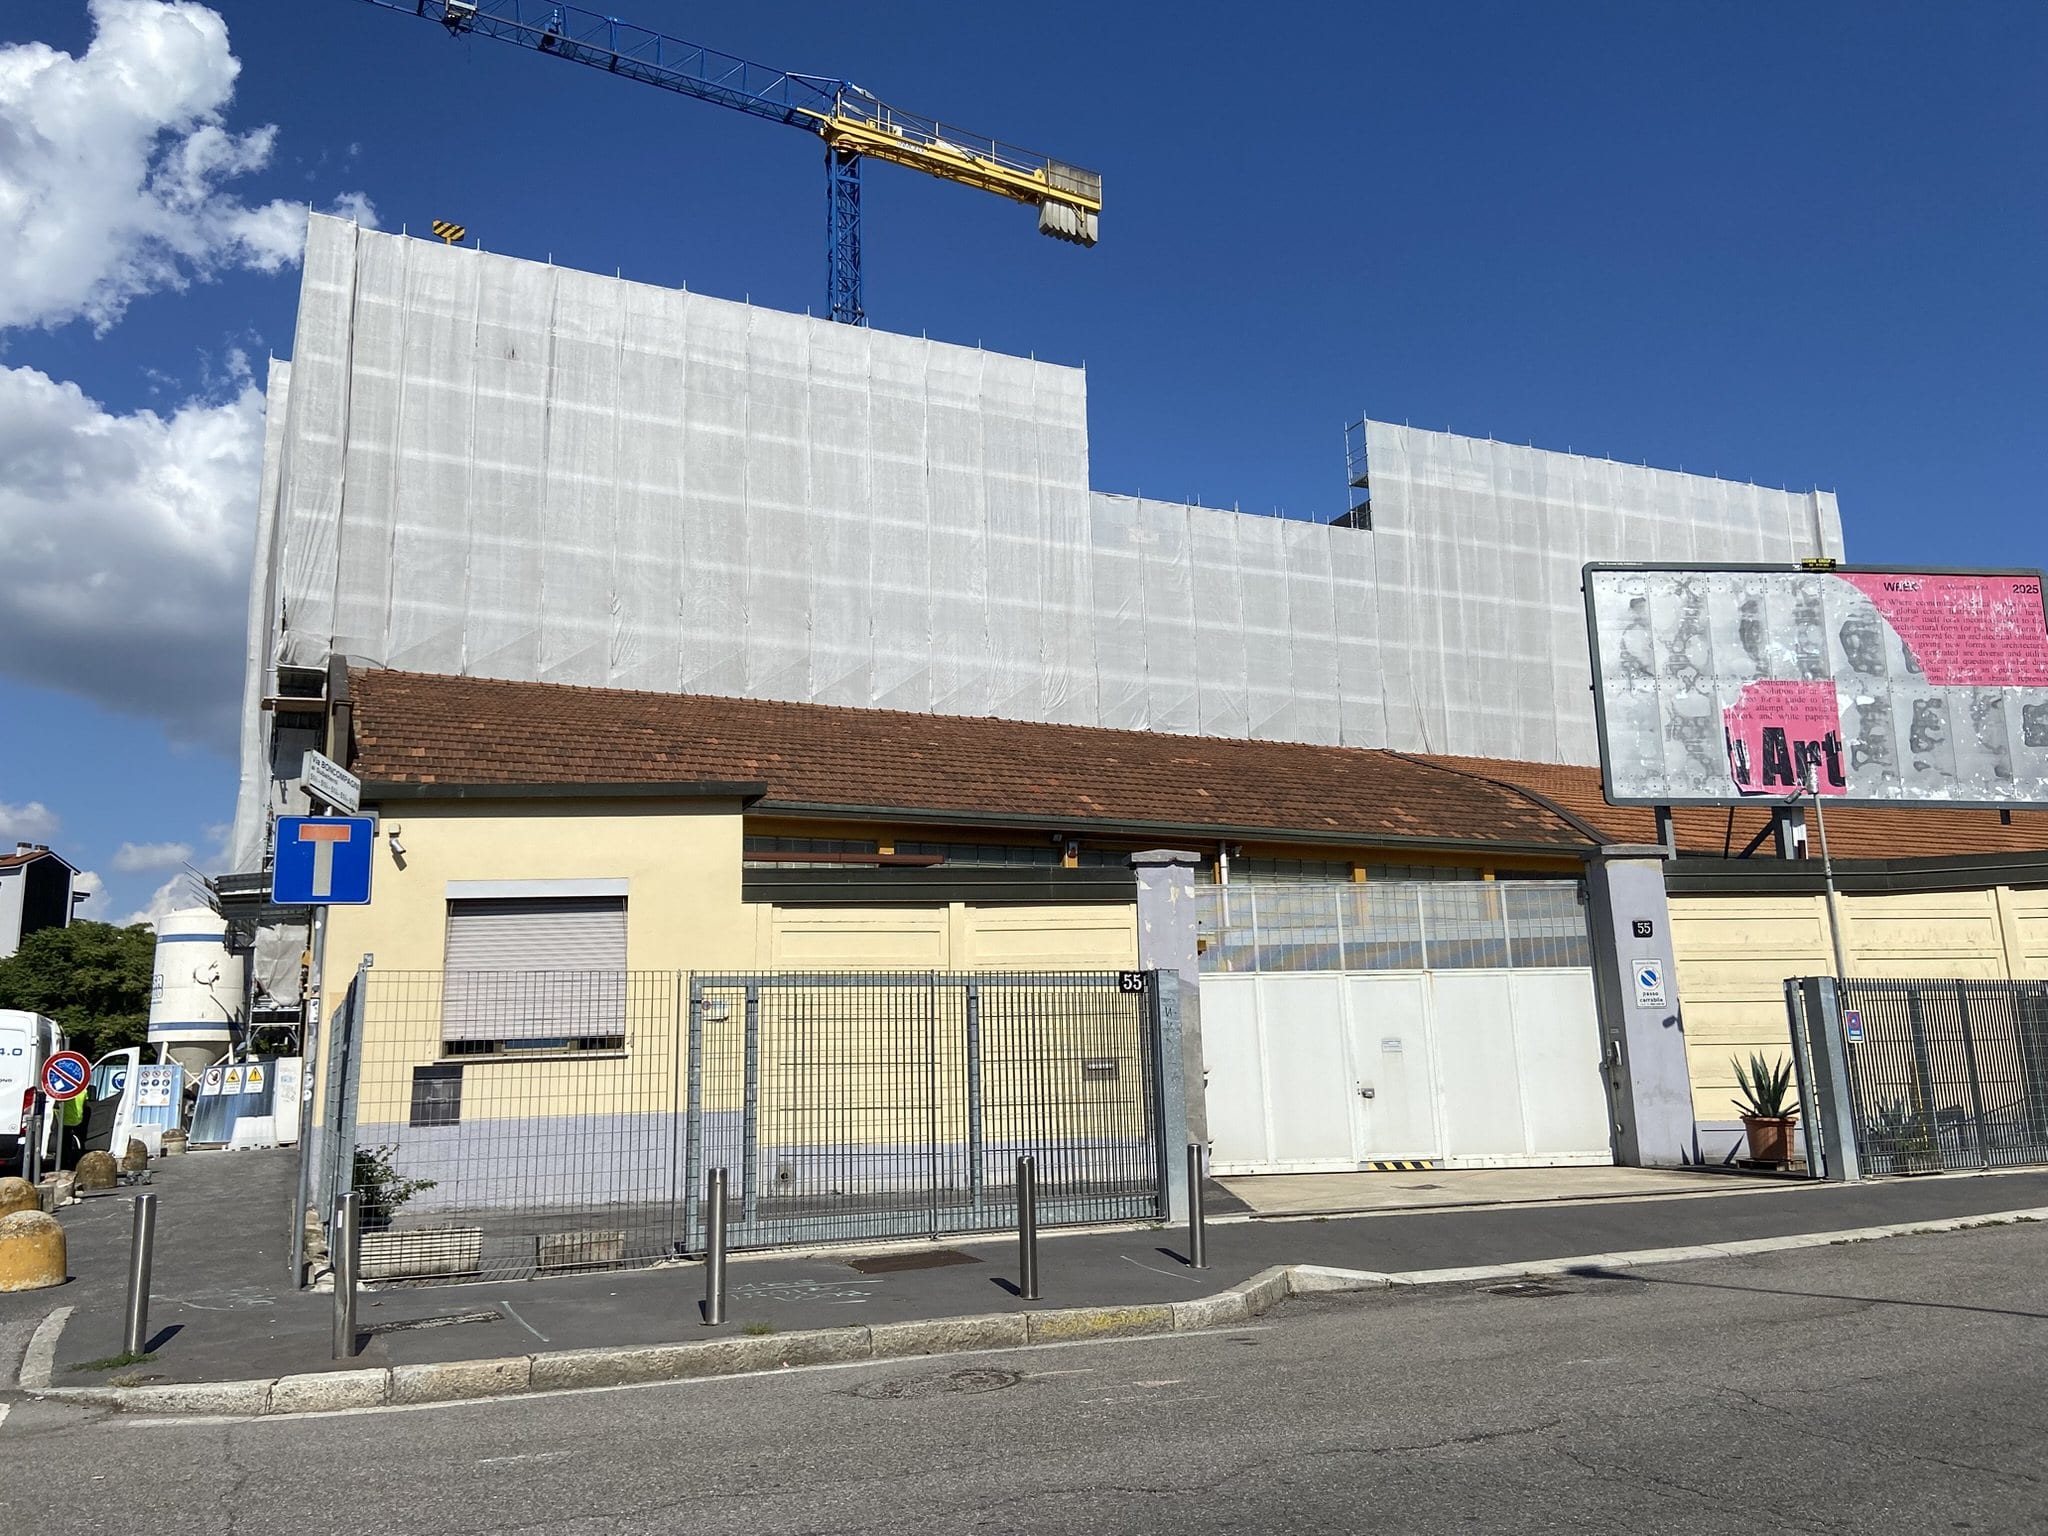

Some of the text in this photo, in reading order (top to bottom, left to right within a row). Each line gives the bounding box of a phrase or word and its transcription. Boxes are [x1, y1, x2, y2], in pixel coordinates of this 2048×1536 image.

[2012, 584, 2040, 594] 2025
[1762, 727, 1846, 787] Art
[1637, 922, 1651, 934] 55
[1123, 974, 1142, 990] 55
